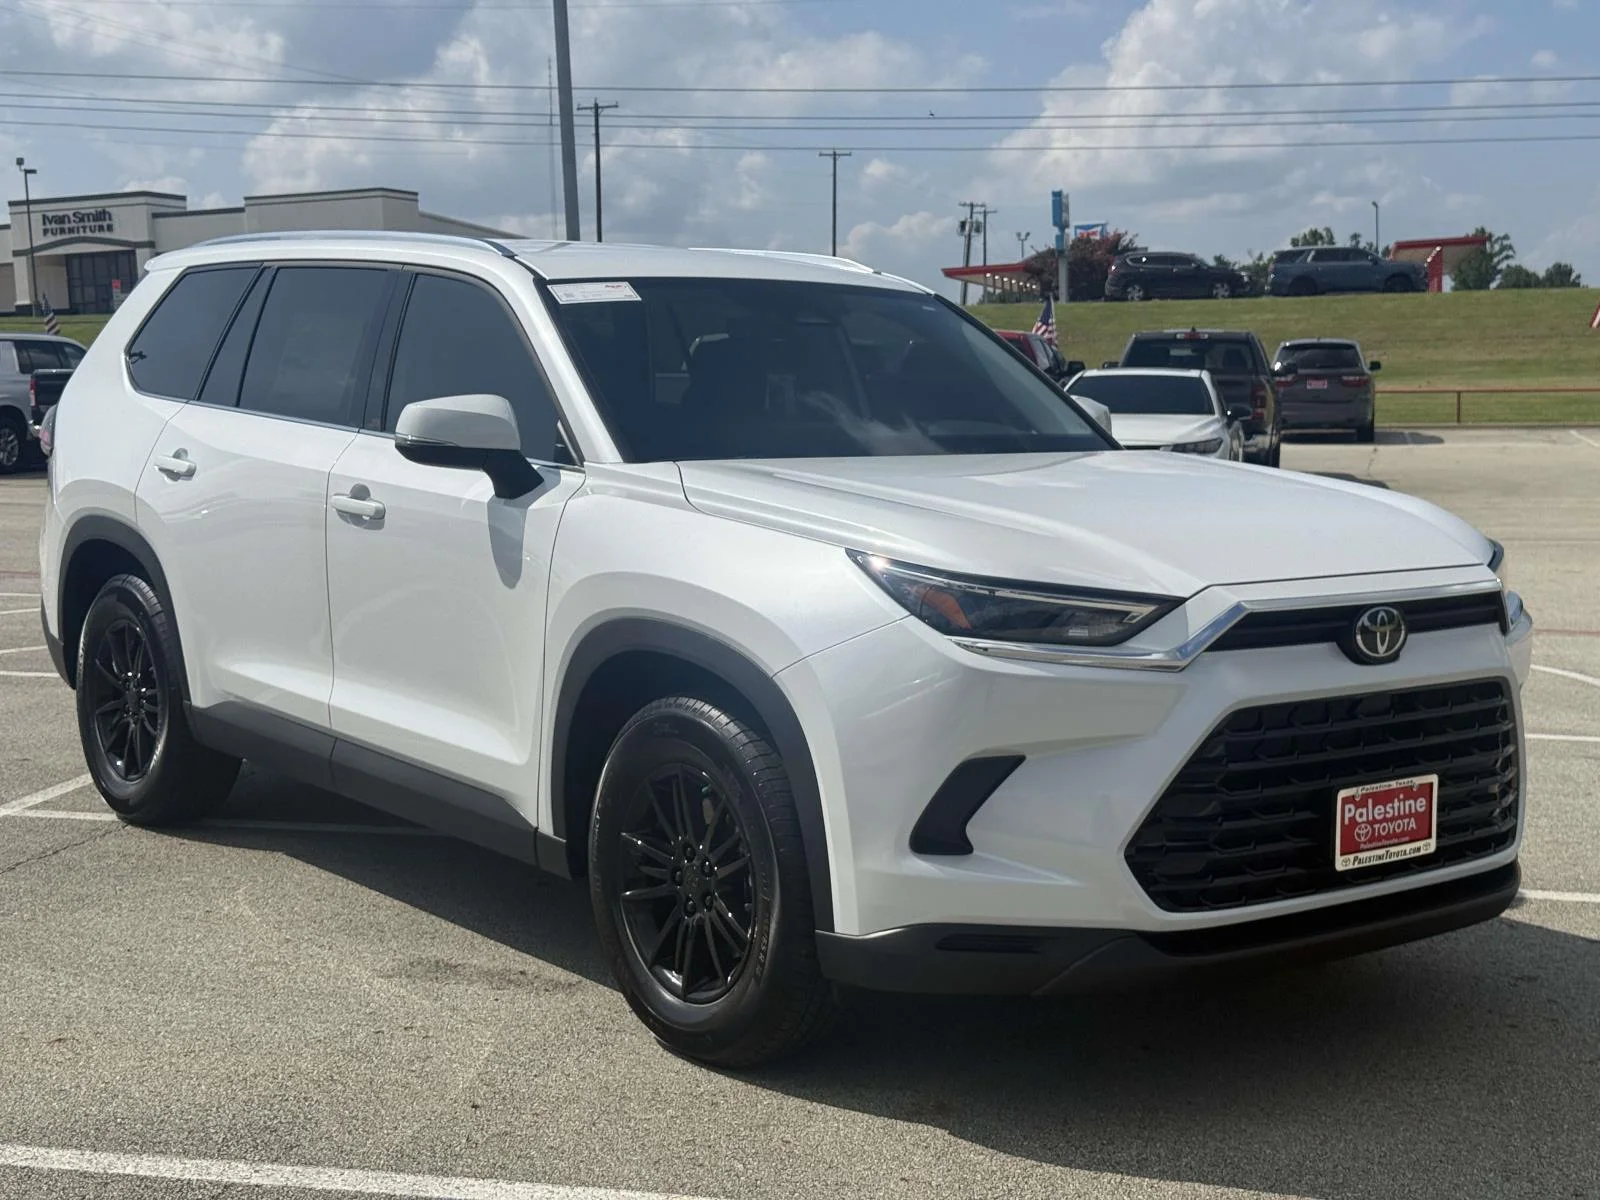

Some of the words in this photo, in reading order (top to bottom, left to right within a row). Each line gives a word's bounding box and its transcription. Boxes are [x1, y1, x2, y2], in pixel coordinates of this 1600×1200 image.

[42, 213, 71, 226] Ivan
[72, 209, 112, 224] Smith
[42, 224, 114, 237] FURNITURE
[1344, 794, 1426, 825] Palestine
[1373, 817, 1416, 837] TOYOTA
